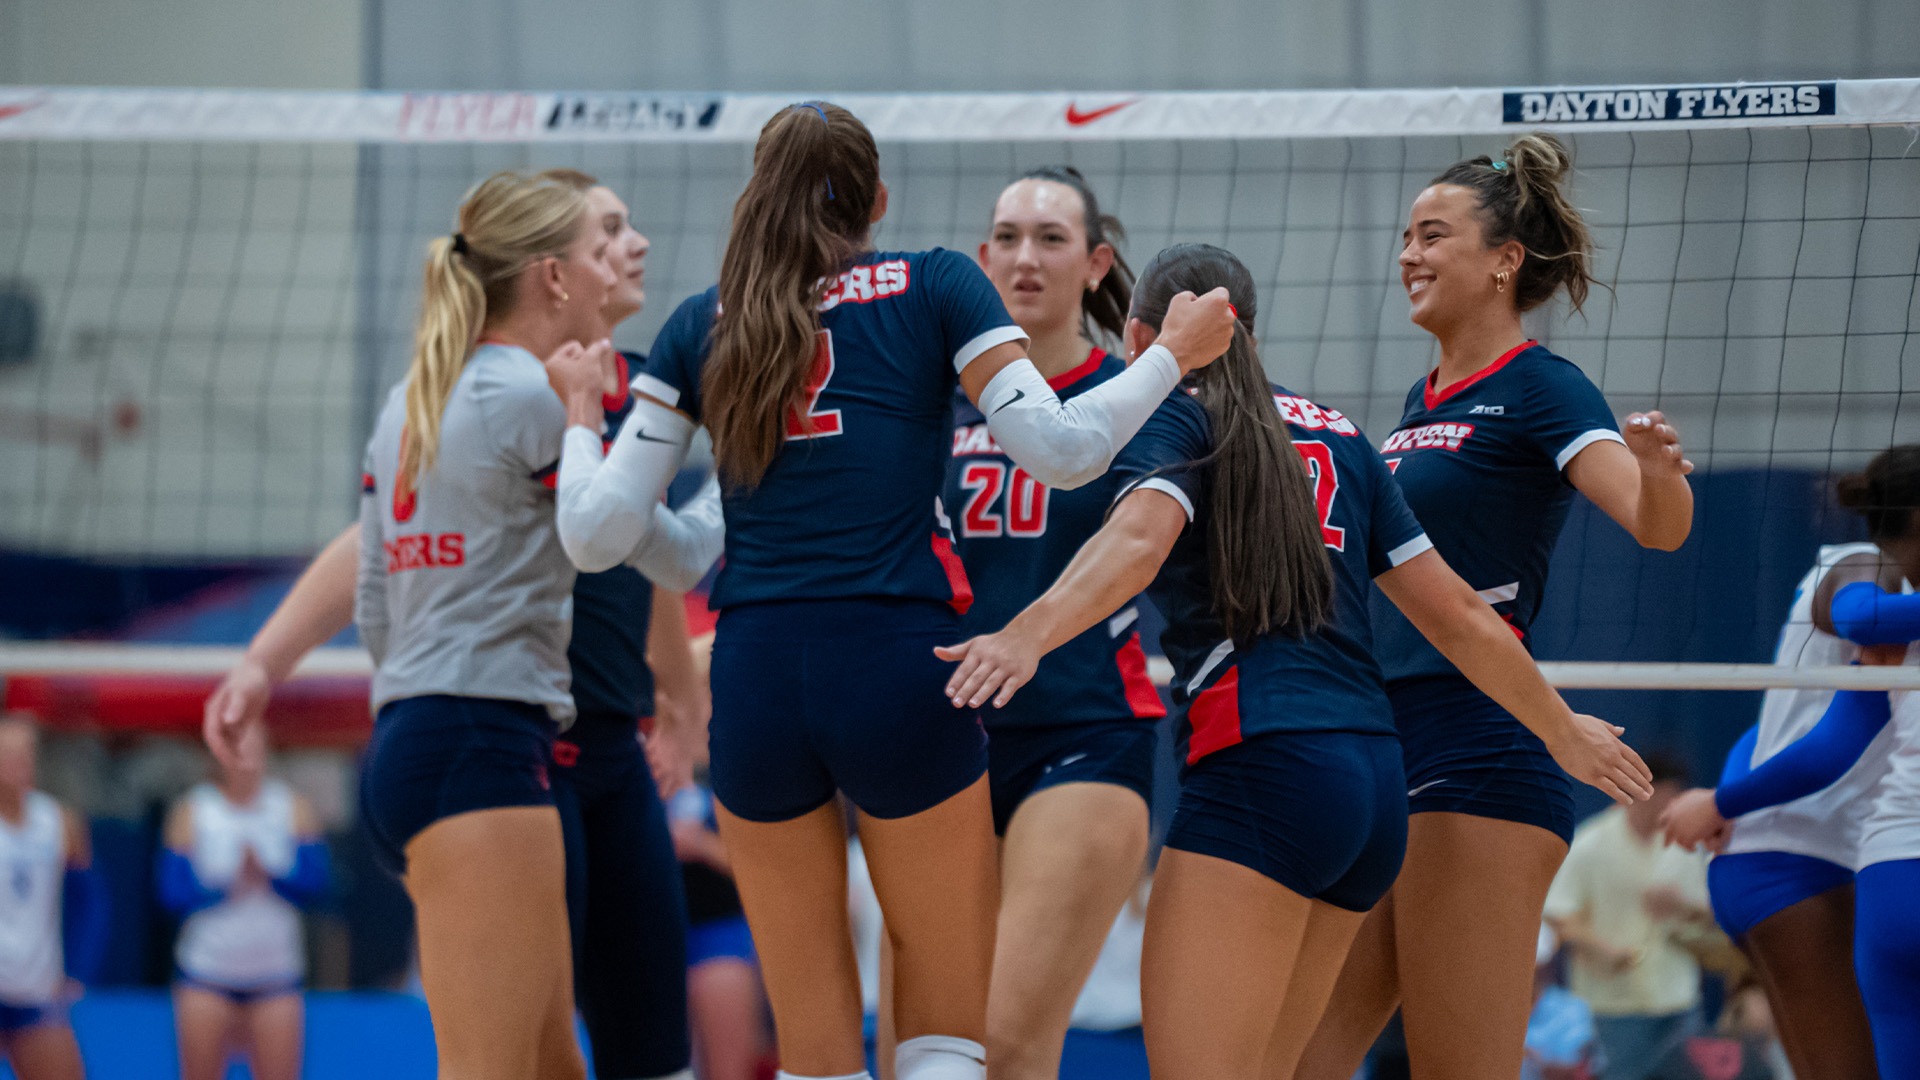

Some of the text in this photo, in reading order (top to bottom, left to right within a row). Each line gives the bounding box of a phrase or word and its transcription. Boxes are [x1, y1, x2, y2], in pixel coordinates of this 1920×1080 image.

[1521, 85, 1821, 123] DAYTON FLYERS
[960, 460, 1051, 539] 20
